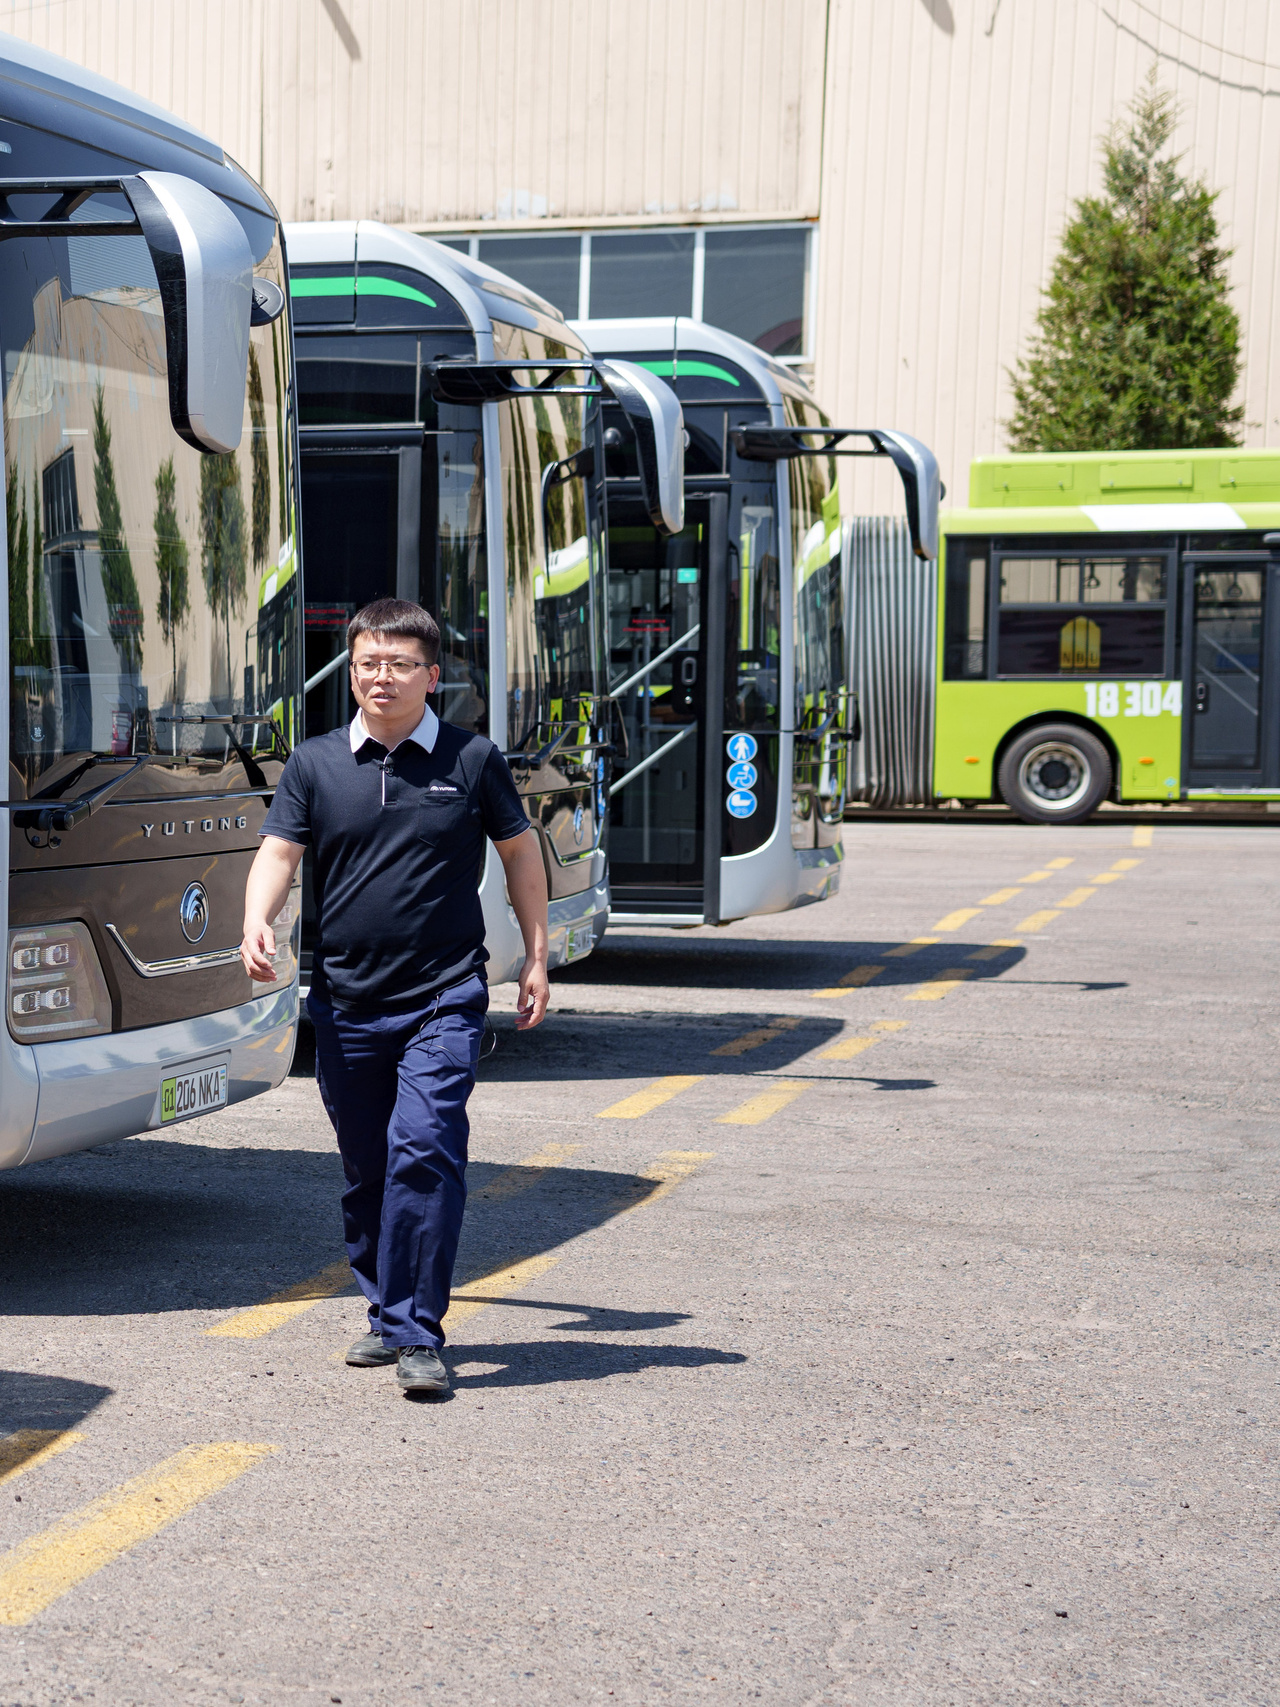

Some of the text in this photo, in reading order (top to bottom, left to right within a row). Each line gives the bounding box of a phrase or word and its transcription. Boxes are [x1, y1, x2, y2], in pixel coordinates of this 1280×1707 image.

[1062, 653, 1098, 665] NBU
[1084, 681, 1182, 718] 18 304
[141, 816, 247, 838] YUTONG
[164, 1070, 220, 1113] 01 206 NKA
